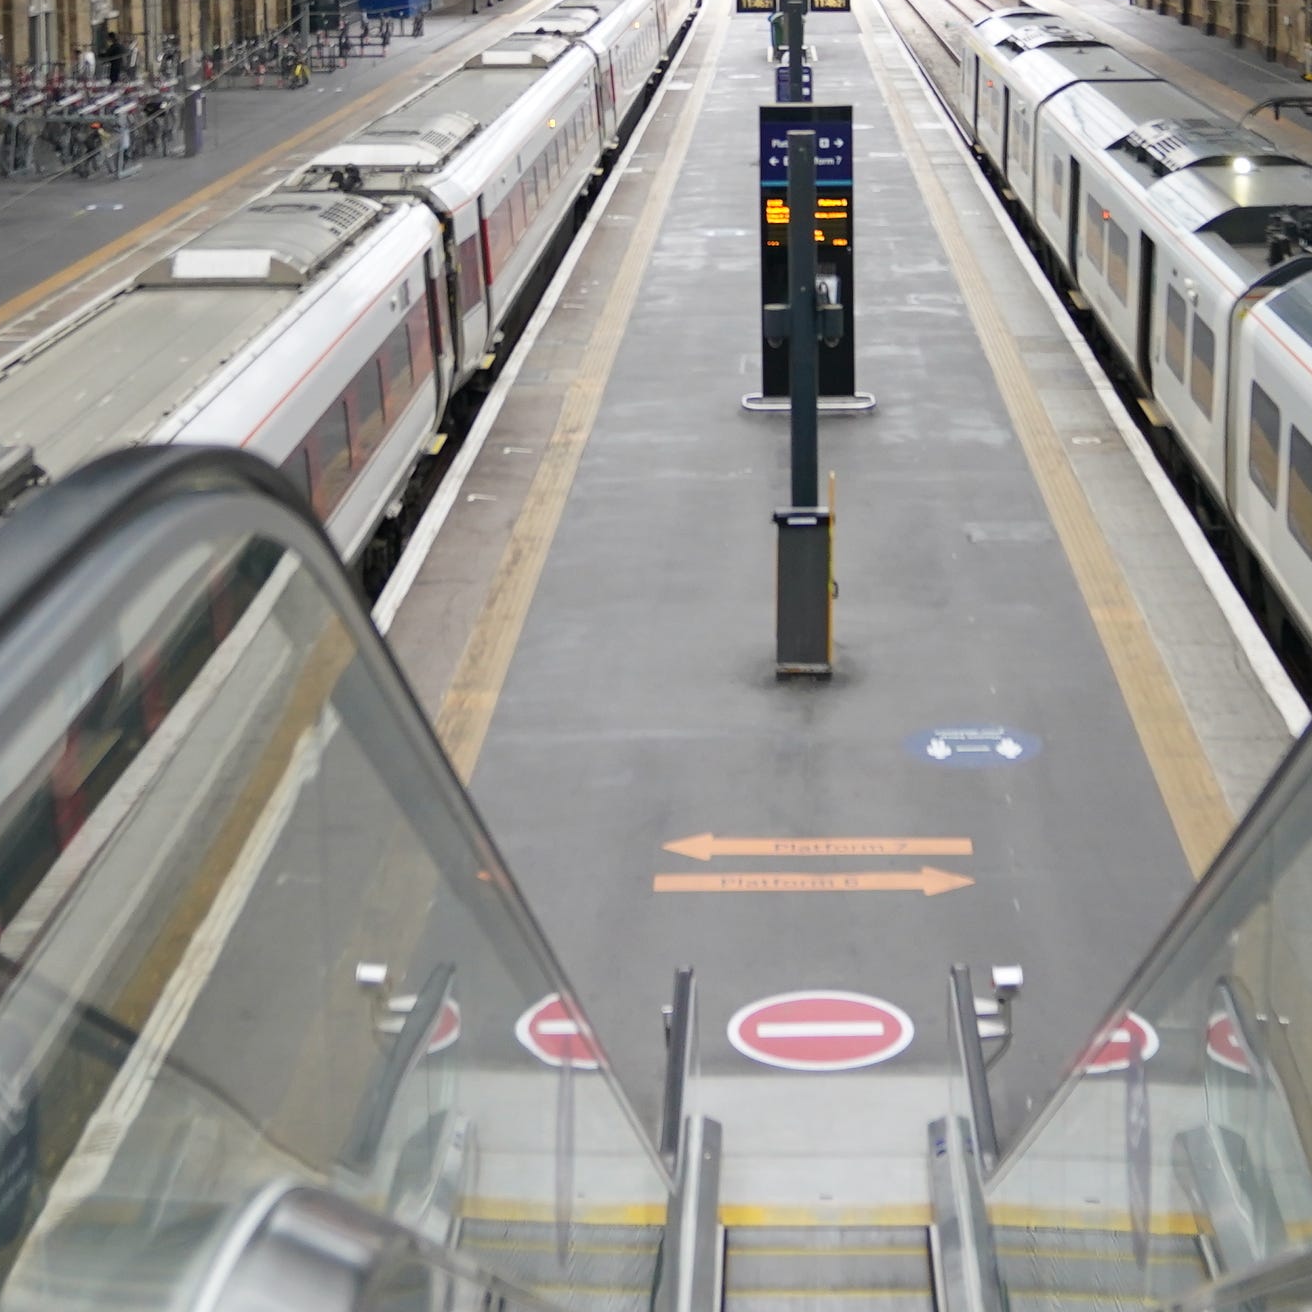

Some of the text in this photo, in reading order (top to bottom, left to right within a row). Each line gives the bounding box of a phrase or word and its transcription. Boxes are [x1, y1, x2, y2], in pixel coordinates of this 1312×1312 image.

[774, 842, 908, 854] Platform 7
[720, 877, 835, 889] Platform
